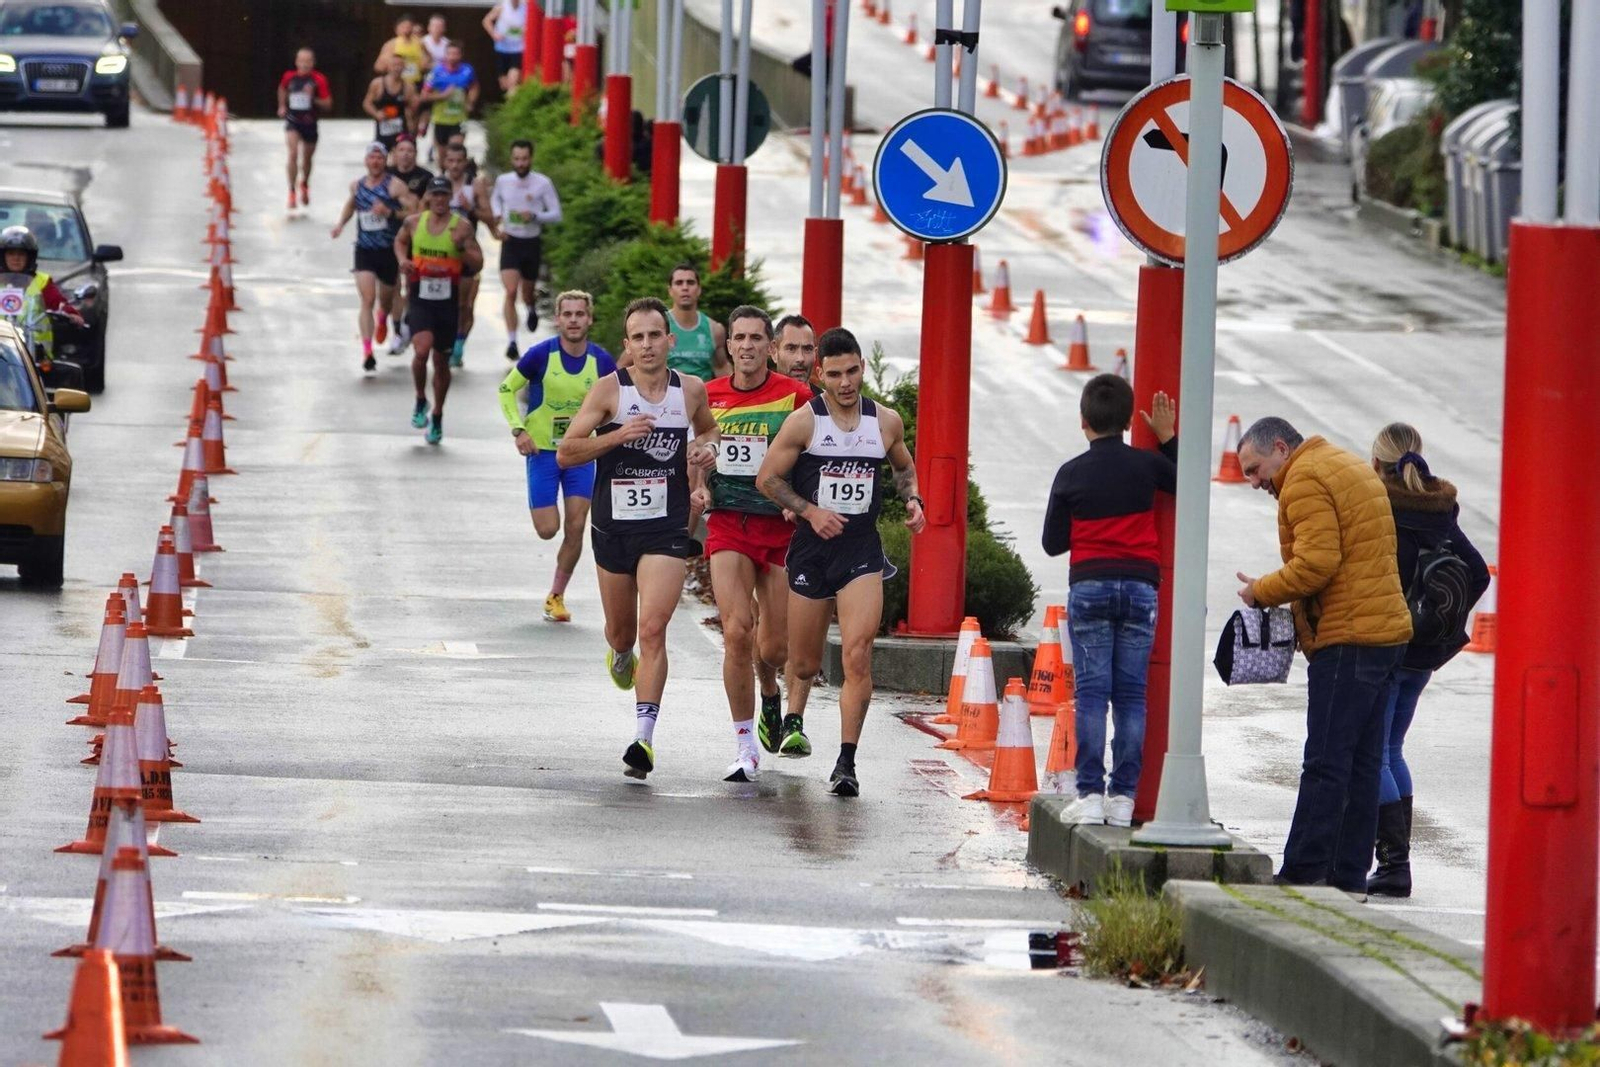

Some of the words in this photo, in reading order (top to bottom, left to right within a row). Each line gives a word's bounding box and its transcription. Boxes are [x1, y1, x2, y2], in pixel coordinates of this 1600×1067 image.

[428, 283, 442, 293] 62
[726, 444, 752, 463] 93
[626, 488, 652, 507] 35
[829, 482, 865, 501] 195
